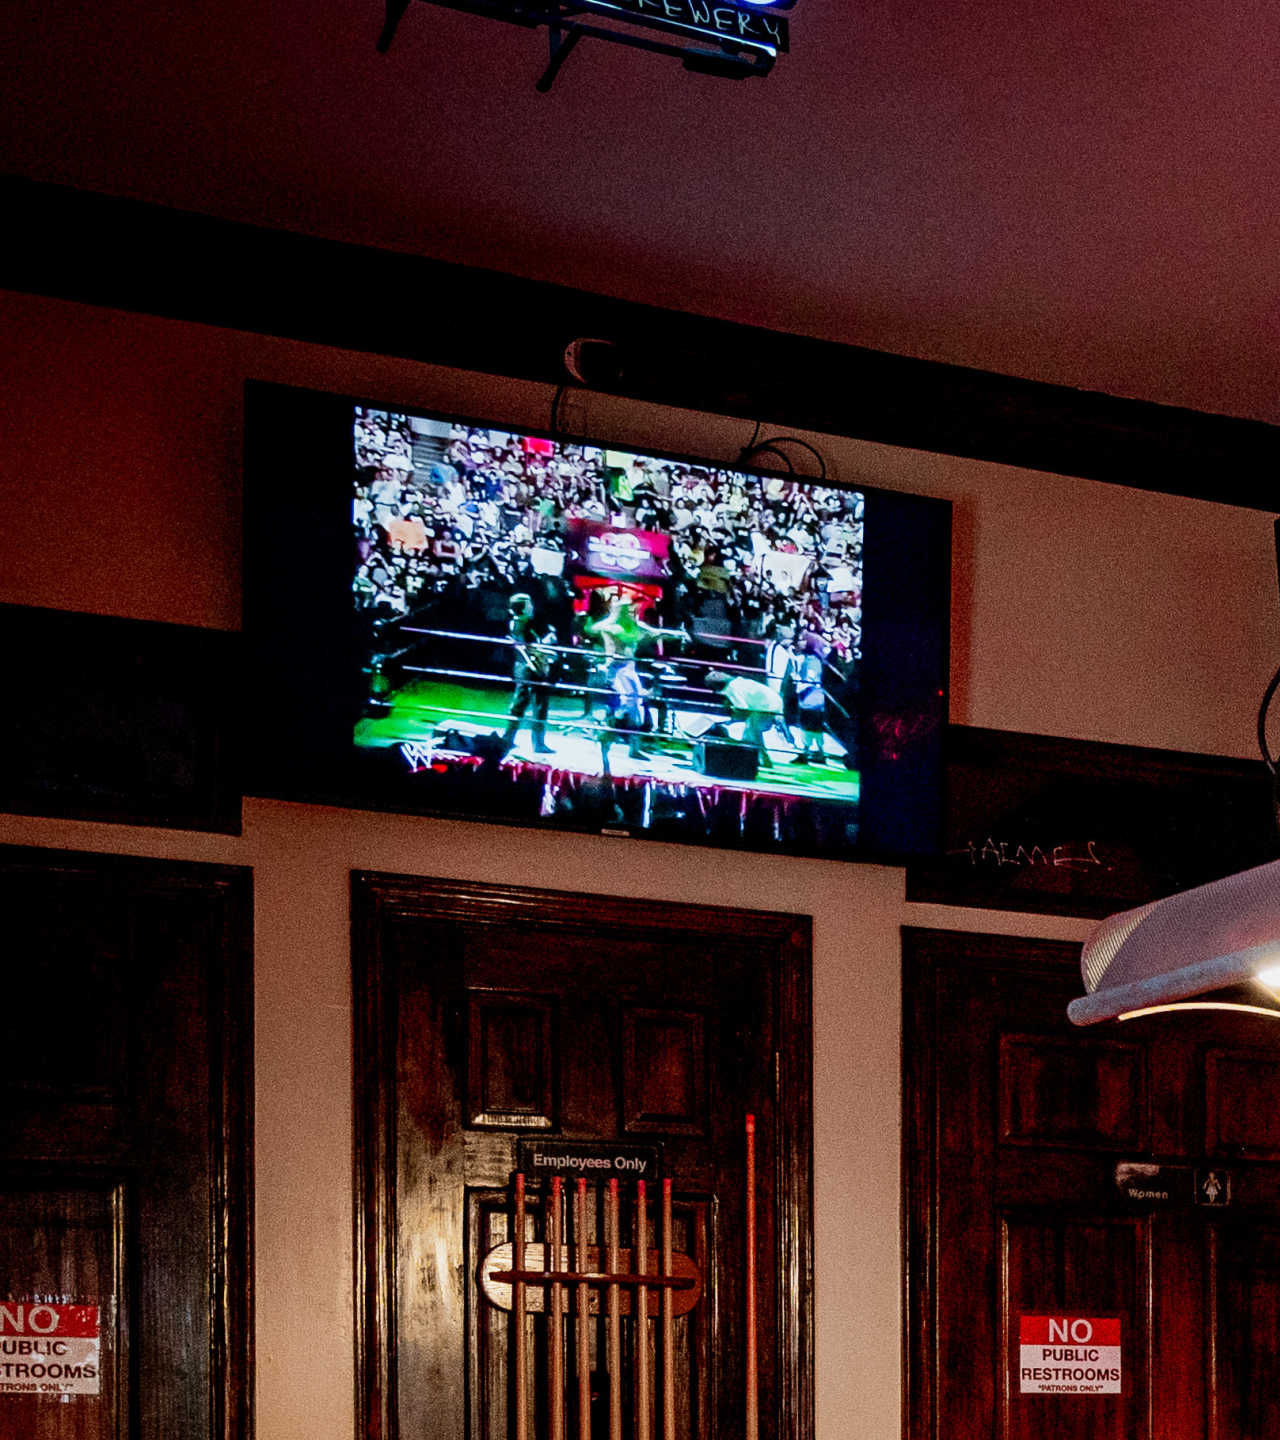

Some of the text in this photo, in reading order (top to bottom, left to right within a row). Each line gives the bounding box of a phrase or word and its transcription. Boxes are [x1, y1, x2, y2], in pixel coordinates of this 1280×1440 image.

[533, 1153, 648, 1173] Employees Only
[1128, 1188, 1169, 1200] Women
[0, 1304, 60, 1335] NO
[1048, 1318, 1093, 1344] NO
[0, 1341, 67, 1356] UBLIC
[1042, 1348, 1100, 1362] PUBLIC
[0, 1363, 96, 1379] TROOMS
[1021, 1367, 1120, 1381] RESTROOMS
[1037, 1384, 1077, 1393] "PATRONS
